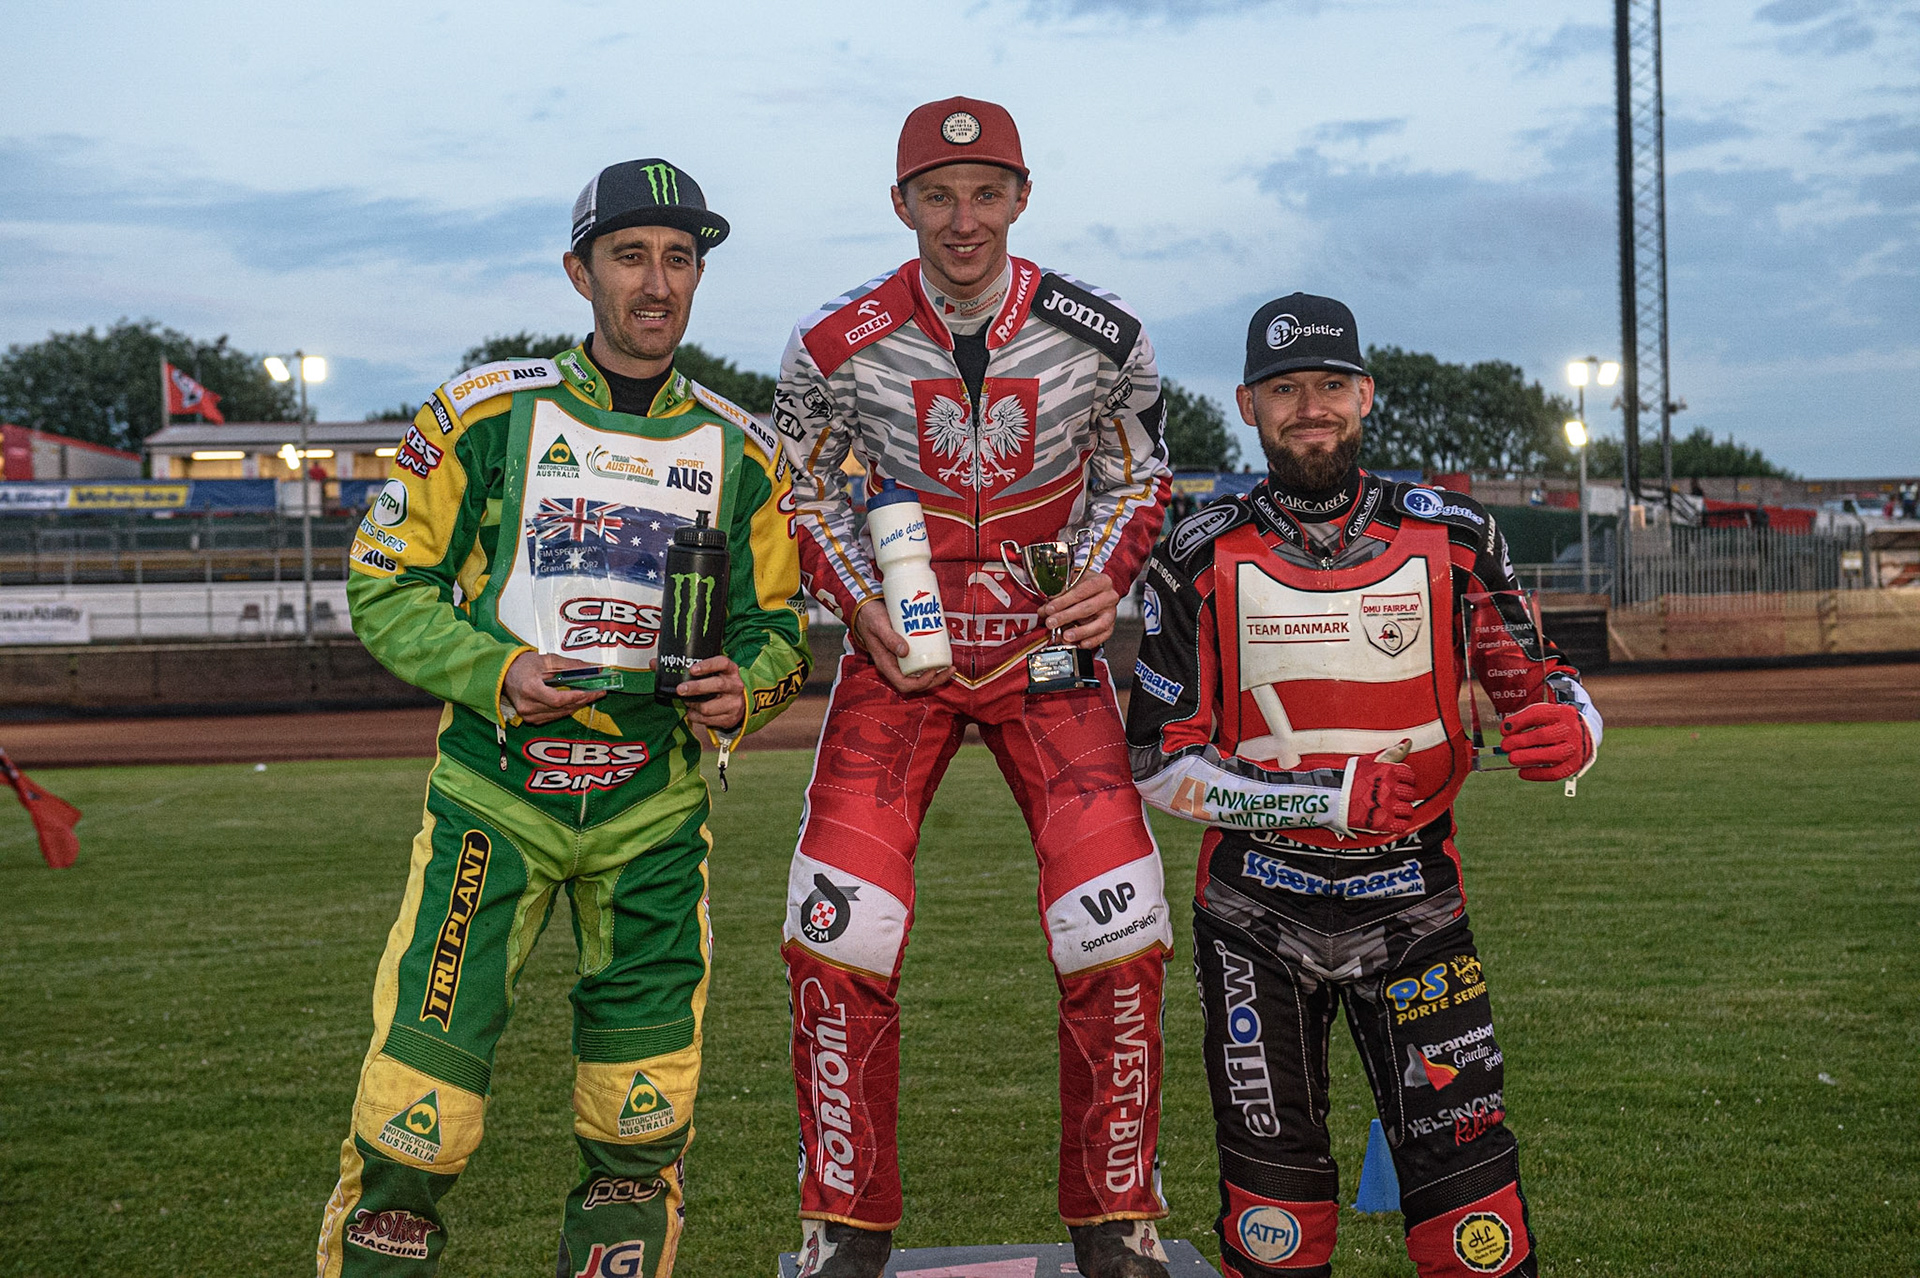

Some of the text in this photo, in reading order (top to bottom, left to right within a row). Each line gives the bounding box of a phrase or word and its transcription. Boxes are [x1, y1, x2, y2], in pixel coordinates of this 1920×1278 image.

[849, 315, 891, 341] ORLEN
[1291, 322, 1344, 337] logistics
[452, 370, 511, 401] SPORT
[513, 366, 548, 381] AUS
[701, 387, 776, 449] SPORT AUS
[406, 425, 441, 467] CBS
[536, 470, 580, 479] AUSTRALIA
[537, 464, 580, 473] MOTORCYCLING
[605, 461, 654, 477] AUSTRALIA
[676, 458, 705, 469] SPORT
[666, 466, 713, 496] AUS
[378, 491, 400, 515] ATPI
[1273, 488, 1349, 512] GARCAREK
[1348, 486, 1380, 537] GARCAREK
[1257, 496, 1299, 540] GARCAREK
[1431, 502, 1485, 525] logistics
[1177, 511, 1226, 548] GANTECH
[361, 549, 398, 571] AUS
[565, 600, 661, 631] CBS
[900, 595, 941, 620] Smak
[1383, 604, 1419, 613] FAIRPLAY
[903, 616, 943, 634] MAK
[945, 616, 1030, 642] RLEN
[1246, 622, 1350, 636] TEAM DANMARK
[1475, 623, 1534, 634] FIM SPEEDWAY
[1477, 641, 1501, 650] Grand
[1501, 640, 1518, 648] Prix
[1487, 668, 1529, 678] Glasgow
[1492, 689, 1528, 699] 19.06.21
[527, 742, 646, 766] CBS
[530, 766, 637, 790] BINS
[1206, 786, 1330, 814] ANNEBERGS
[1246, 852, 1421, 898] Kjærgaard
[447, 841, 486, 947] PLANT
[803, 923, 830, 941] PZM
[1081, 912, 1157, 952] SportoweFakty
[1386, 962, 1449, 1012] PS
[1396, 980, 1488, 1025] PORTE SERVICE
[1104, 983, 1146, 1194] INVEST-BUD
[619, 1108, 674, 1127] MOTORCYCLING
[620, 1116, 675, 1136] AUSTRALIA
[378, 1132, 435, 1162] AUSTRALIA
[383, 1123, 440, 1154] MOTORCYCLING
[349, 1233, 427, 1257] MACHINE
[1246, 1222, 1291, 1247] ATPI
